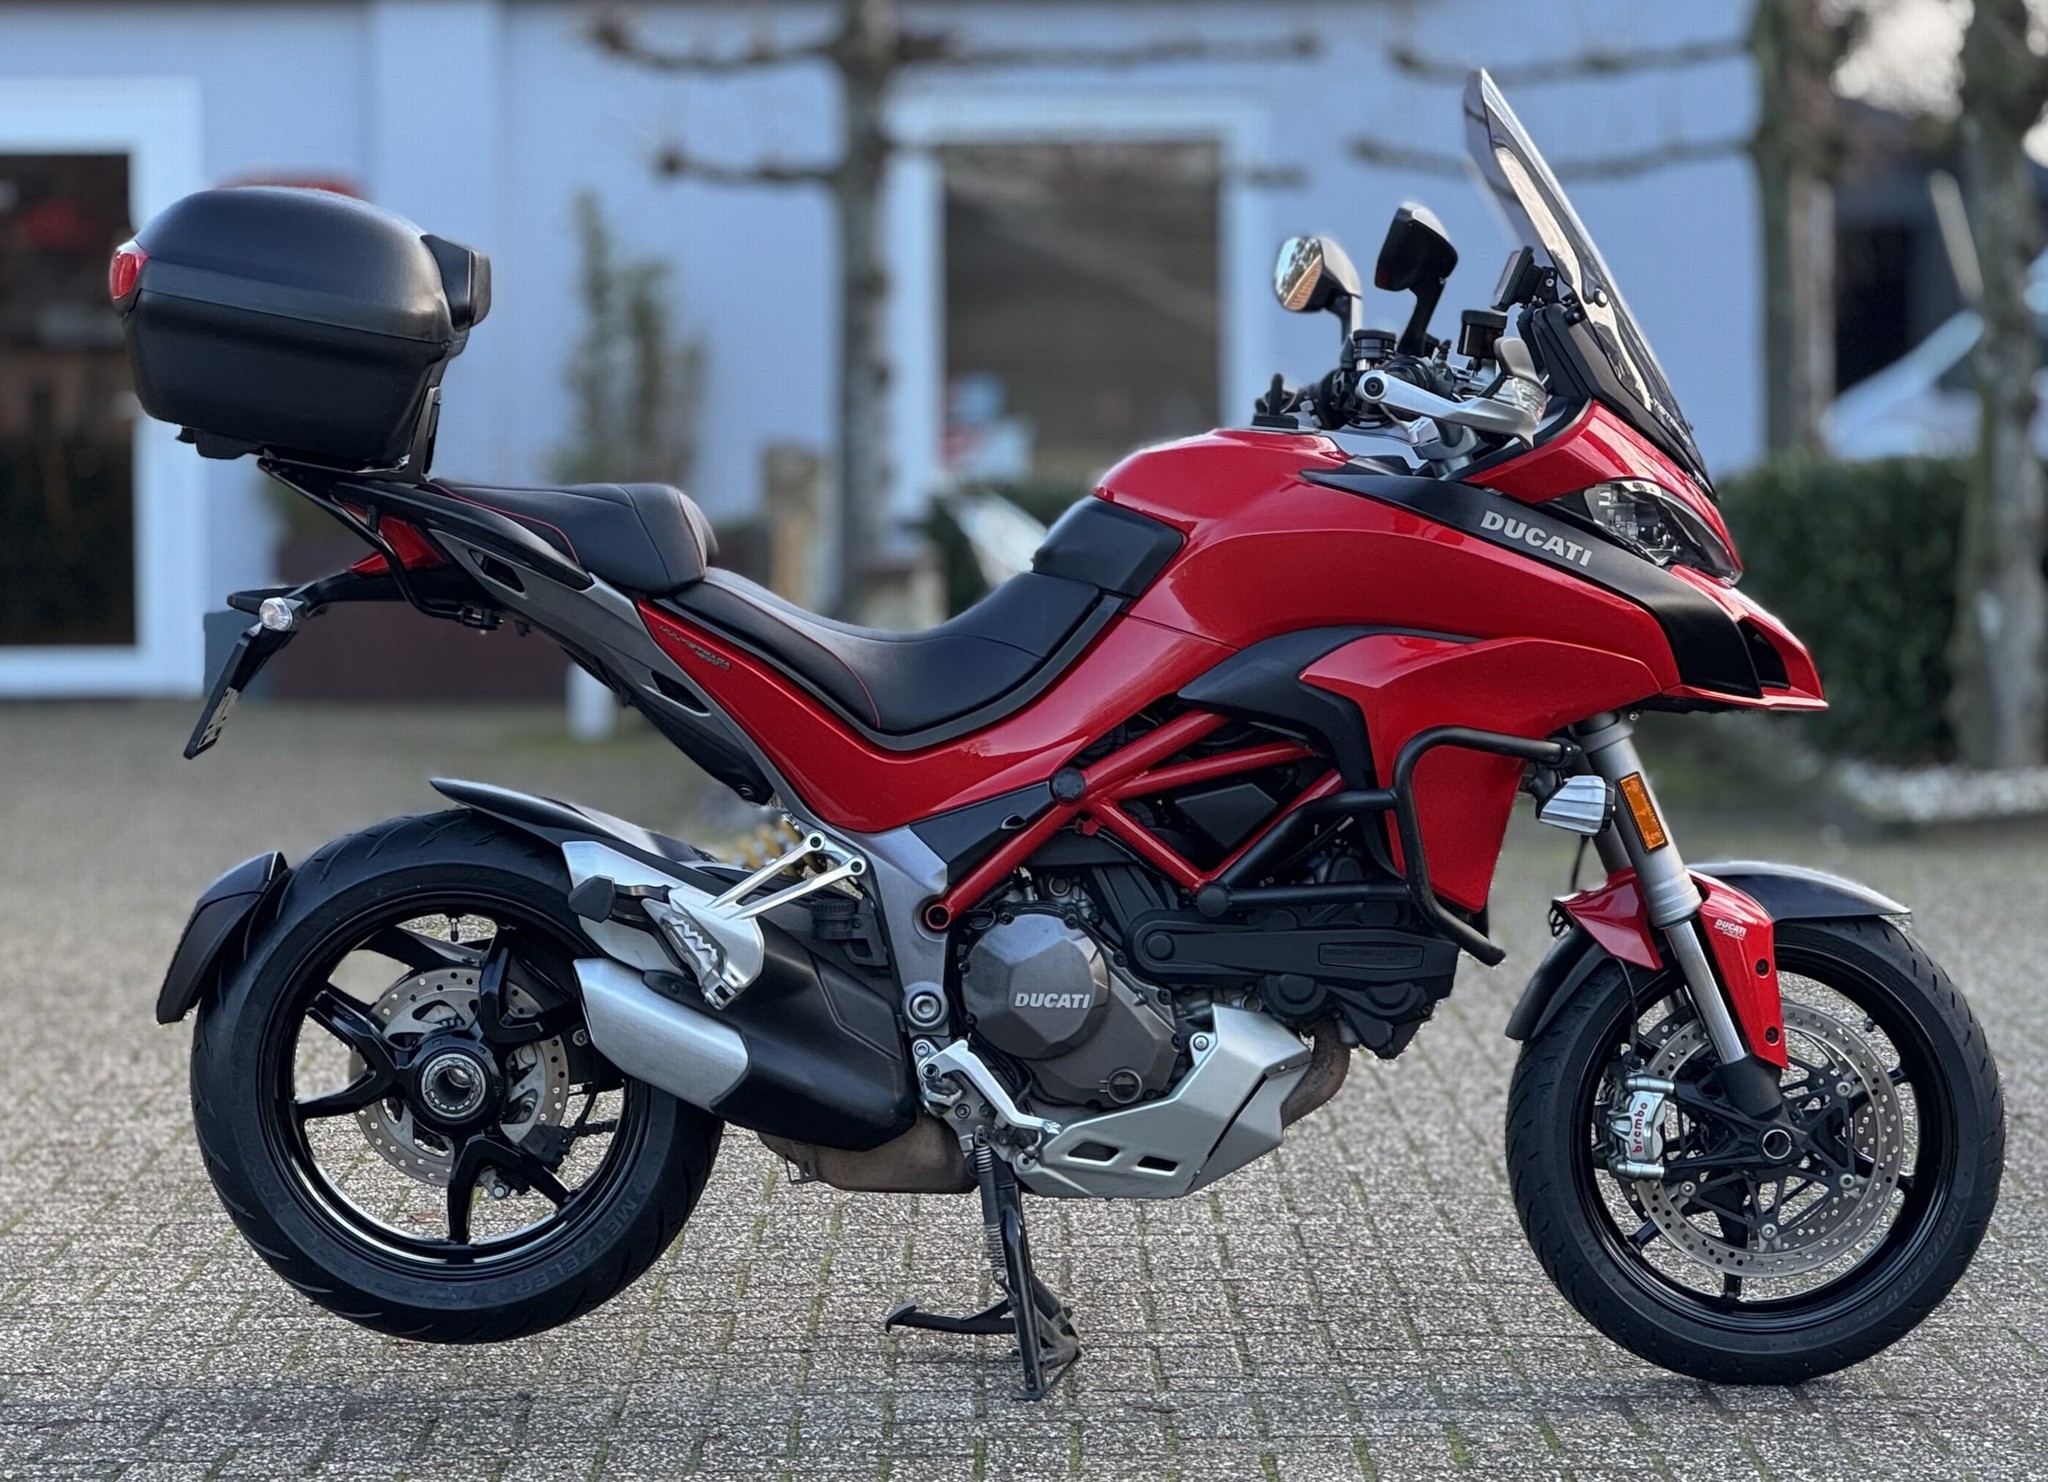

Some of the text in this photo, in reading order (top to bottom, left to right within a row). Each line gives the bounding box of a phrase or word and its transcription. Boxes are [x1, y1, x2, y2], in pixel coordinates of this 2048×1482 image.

[1480, 510, 1593, 567] DUCATI
[1715, 919, 1747, 936] DUCATI
[1014, 992, 1091, 1009] DUCATI
[1633, 1102, 1648, 1153] brembo
